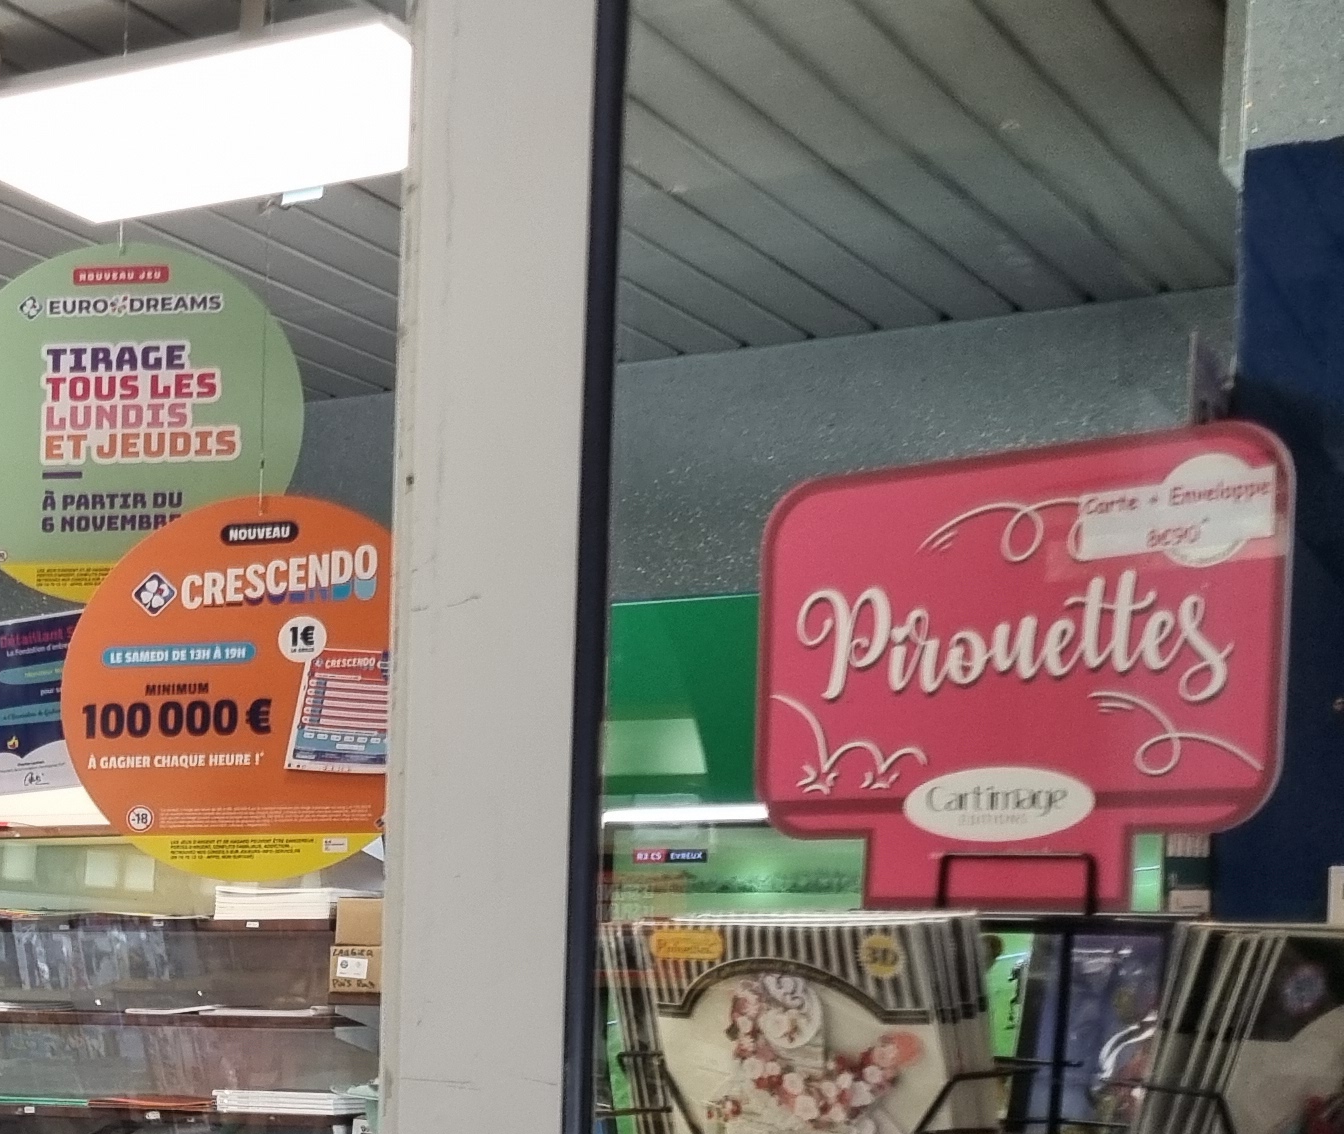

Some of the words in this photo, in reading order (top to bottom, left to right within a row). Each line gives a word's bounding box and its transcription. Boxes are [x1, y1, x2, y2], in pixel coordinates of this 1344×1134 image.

[79, 271, 134, 282] NOUVEAU
[138, 270, 162, 281] JEU
[47, 344, 185, 373] TIRAGE
[46, 375, 140, 402] TOUS
[149, 373, 216, 399] LES
[45, 403, 187, 431] LUNDIS
[45, 435, 85, 461] ET
[97, 430, 236, 458] JEUDIS
[42, 491, 55, 510] À
[62, 493, 146, 510] PARTIR
[153, 492, 182, 508] DU
[42, 517, 54, 533] 6
[229, 527, 290, 541] NOUVEAU
[182, 545, 378, 609] CRESCENDO
[290, 626, 314, 647] 1€
[797, 570, 1234, 700] Pirouettes
[110, 651, 121, 664] LE
[124, 648, 169, 662] SAMEDI
[172, 648, 187, 661] DE
[190, 648, 210, 660] 13H
[213, 644, 223, 659] À
[225, 647, 245, 659] 19H
[325, 658, 376, 669] CRESCENDO
[146, 683, 208, 696] MINIMUM
[88, 754, 98, 770] À
[100, 755, 151, 768] GAGNER
[154, 754, 206, 768] CHAQUE
[209, 753, 250, 766] HEURE
